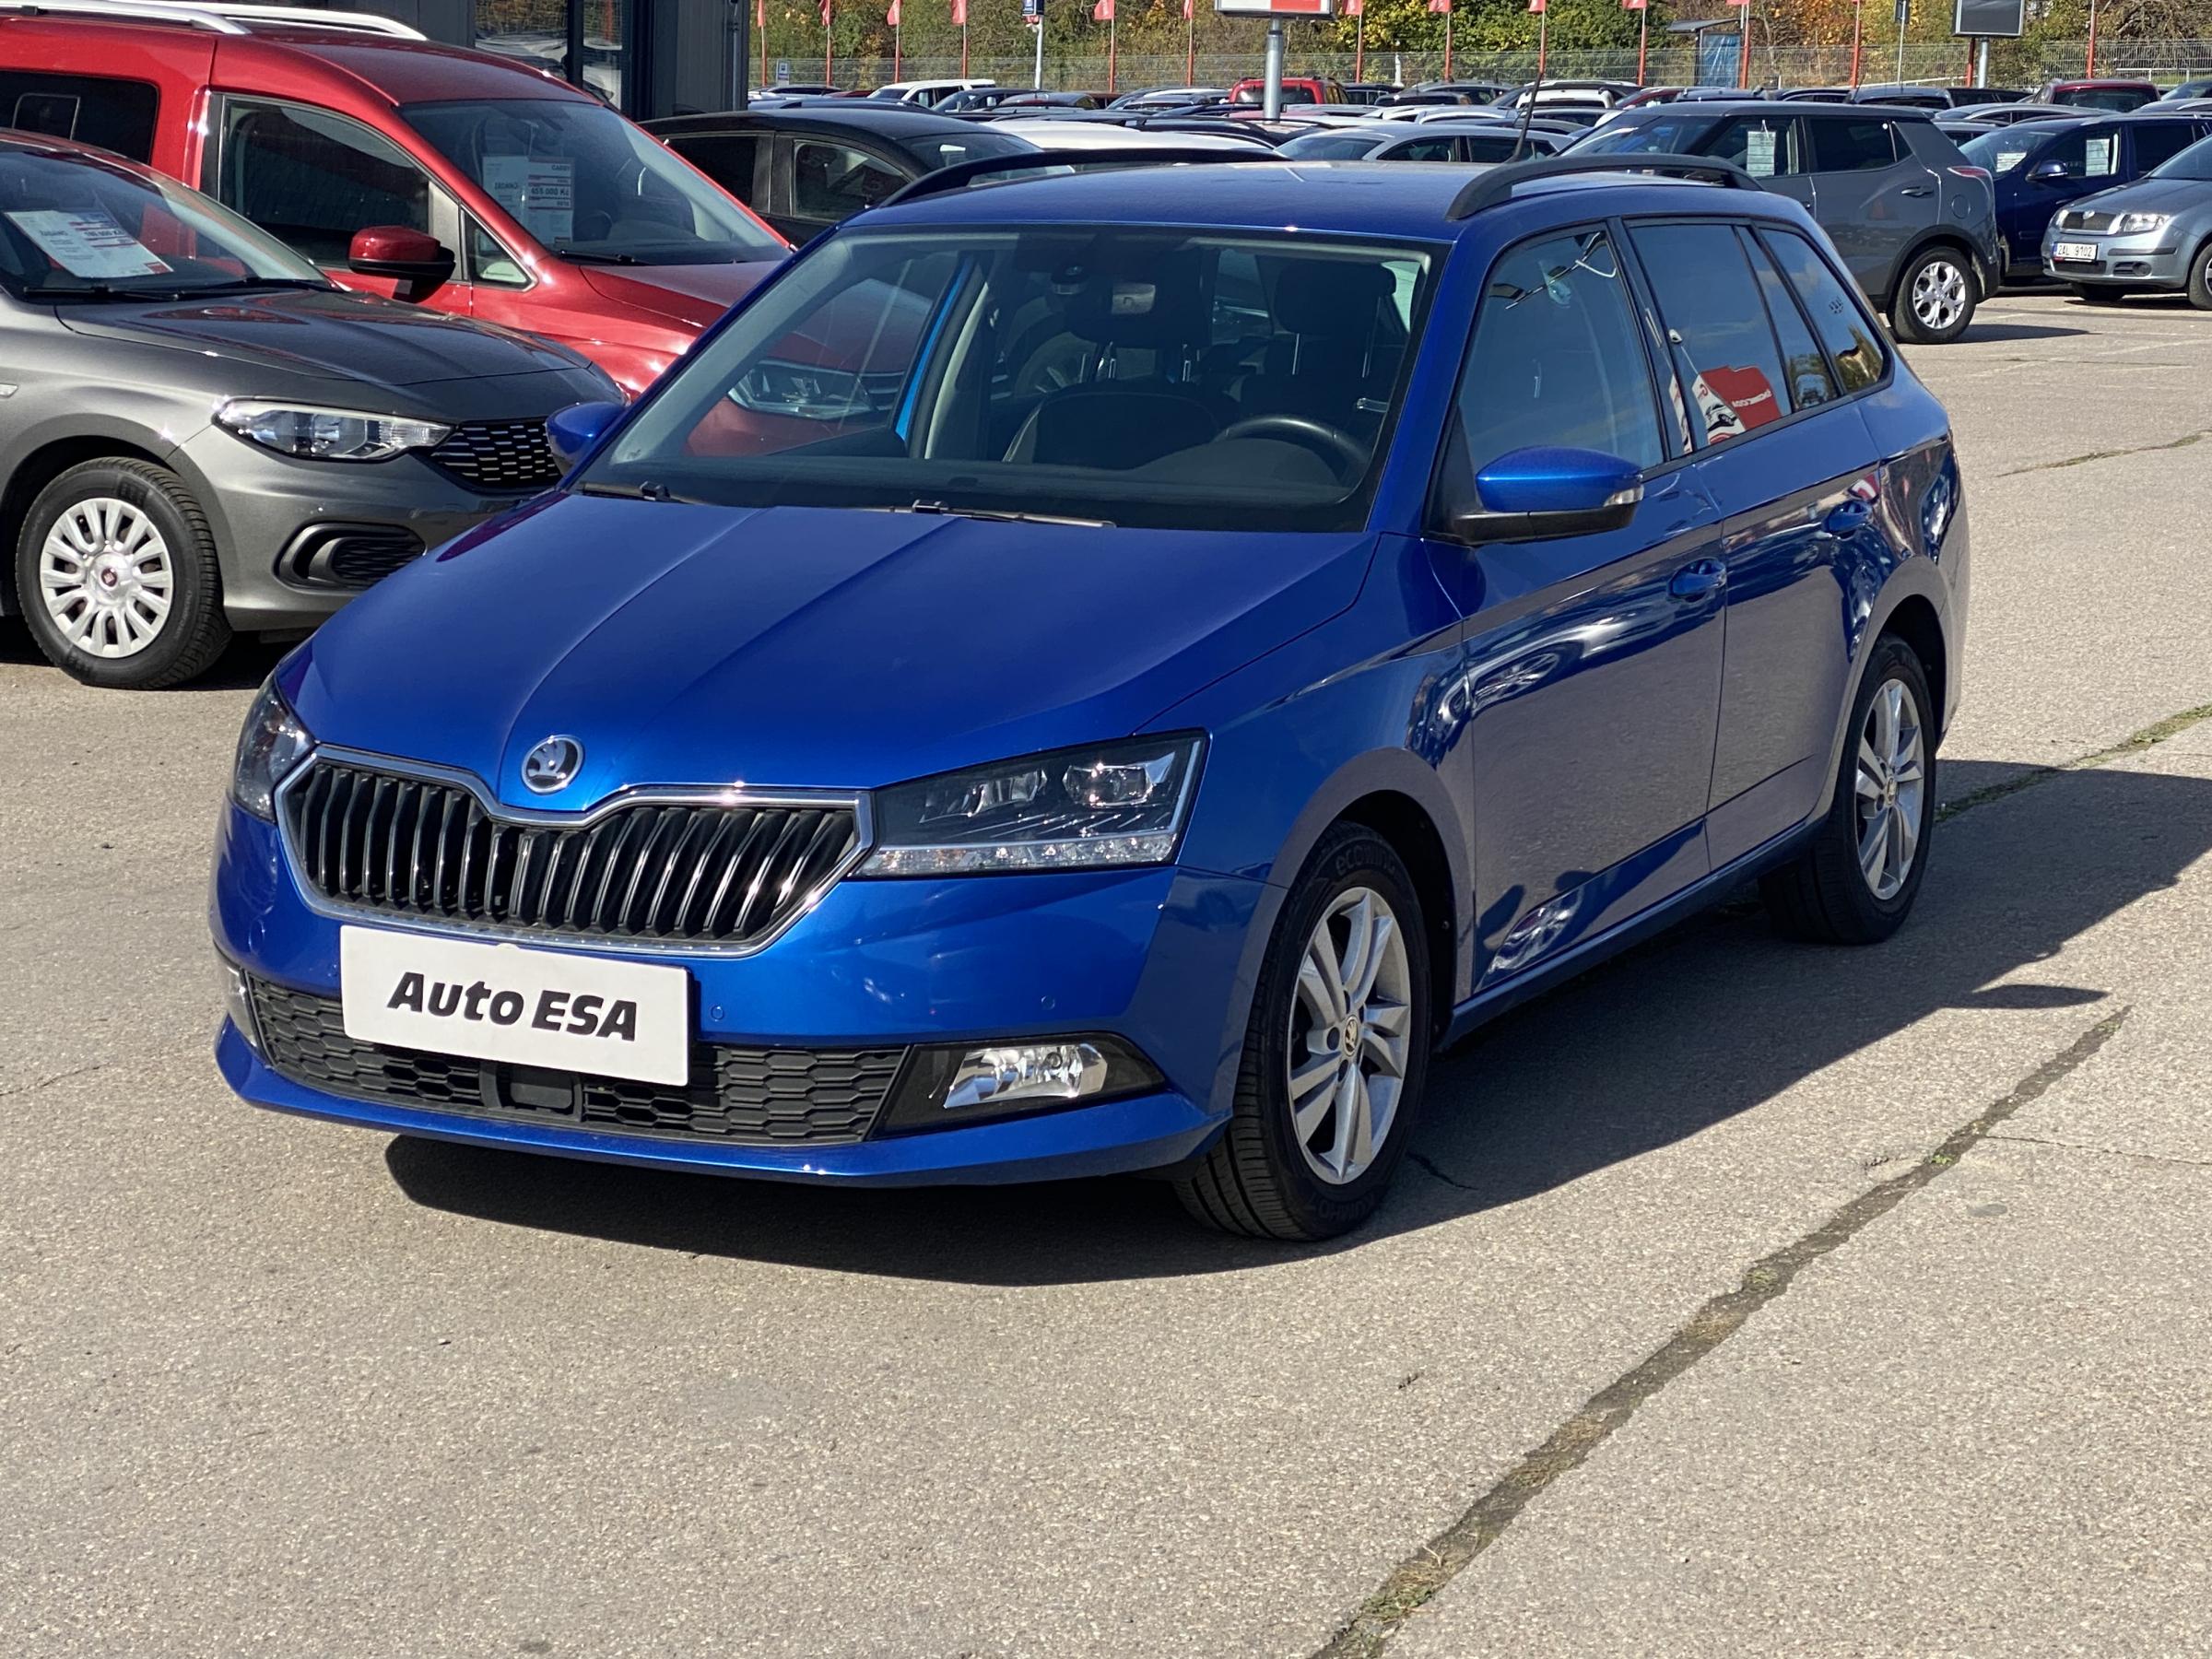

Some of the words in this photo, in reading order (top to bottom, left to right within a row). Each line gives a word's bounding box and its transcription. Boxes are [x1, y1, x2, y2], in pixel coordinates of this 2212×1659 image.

[2058, 244, 2070, 256] 2AL
[2075, 245, 2092, 257] 9102
[386, 971, 524, 1026] Auto
[531, 989, 637, 1042] ESA
